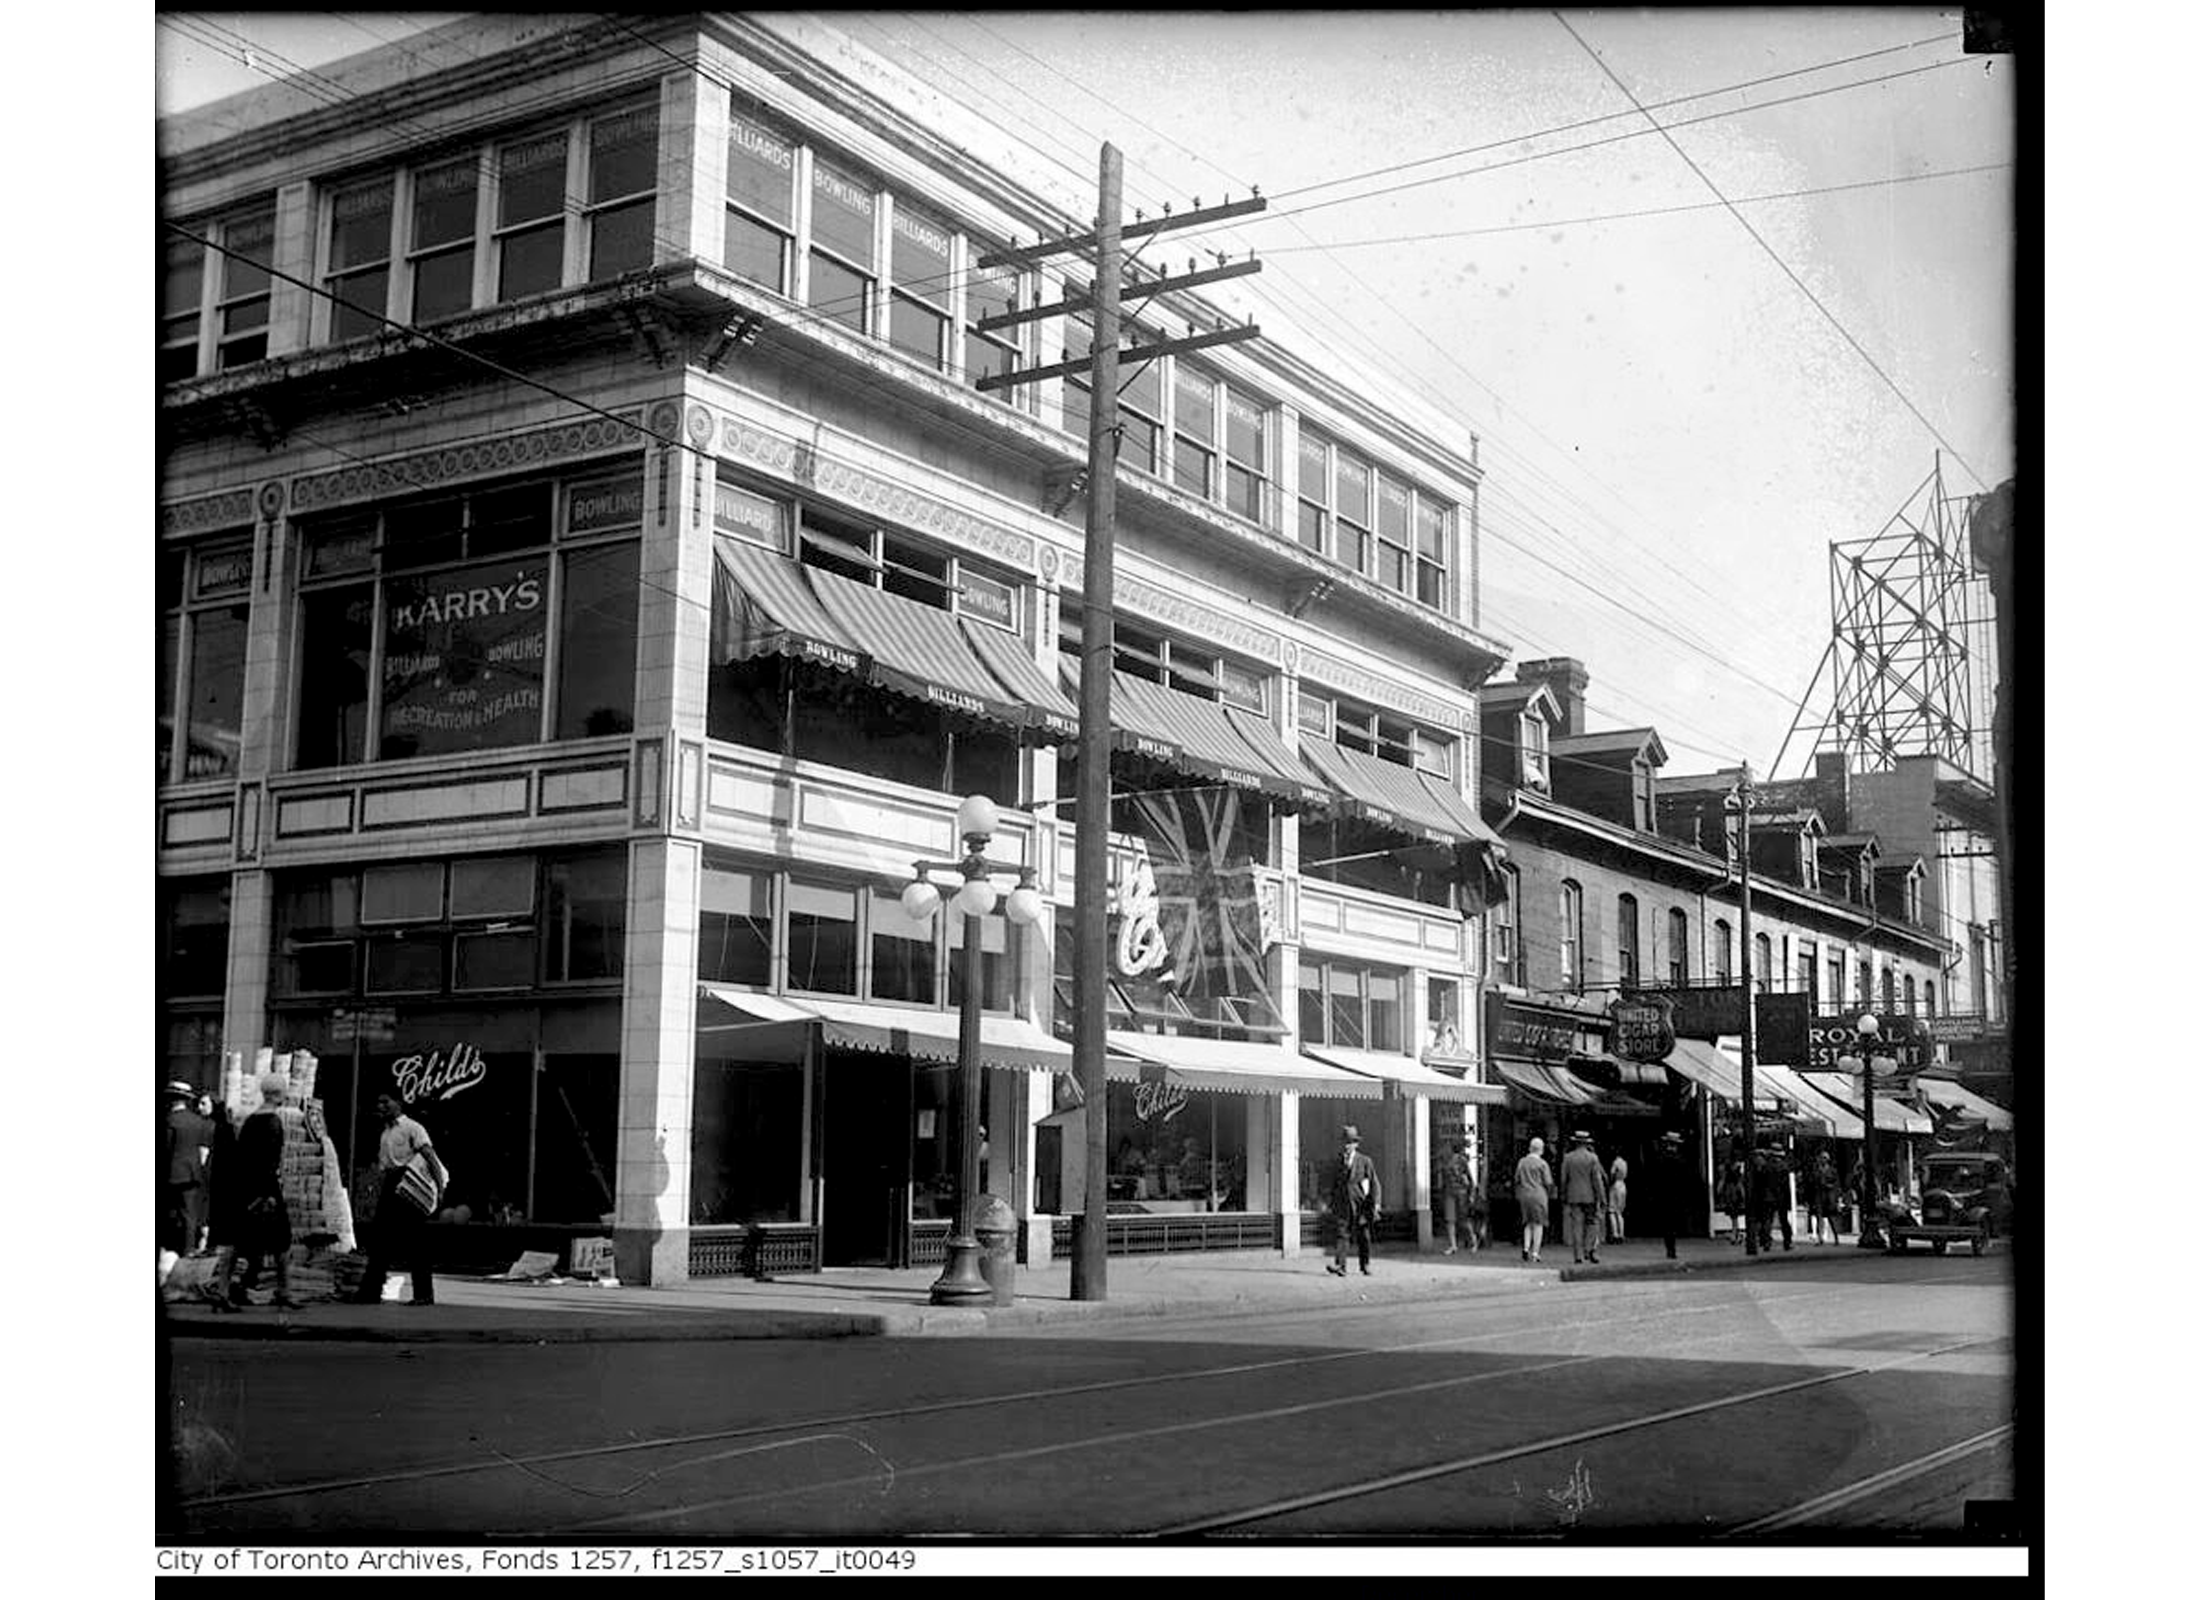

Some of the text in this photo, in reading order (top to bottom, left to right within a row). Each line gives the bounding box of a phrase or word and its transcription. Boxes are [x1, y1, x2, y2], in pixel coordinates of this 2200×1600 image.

[814, 168, 872, 216] BOWLING
[893, 212, 950, 258] BILLIARDS
[574, 491, 642, 521] BOWLING
[395, 570, 541, 629] KARRY'S
[487, 632, 544, 662] BOWLING
[806, 640, 858, 669] BOWLING
[483, 688, 540, 724] HEALTH
[927, 683, 986, 713] BILLIARDS
[1137, 737, 1175, 758] BOWLING
[1617, 1007, 1660, 1023] UNITED
[1618, 1023, 1660, 1038] CIGAR
[391, 1042, 487, 1104] Childs
